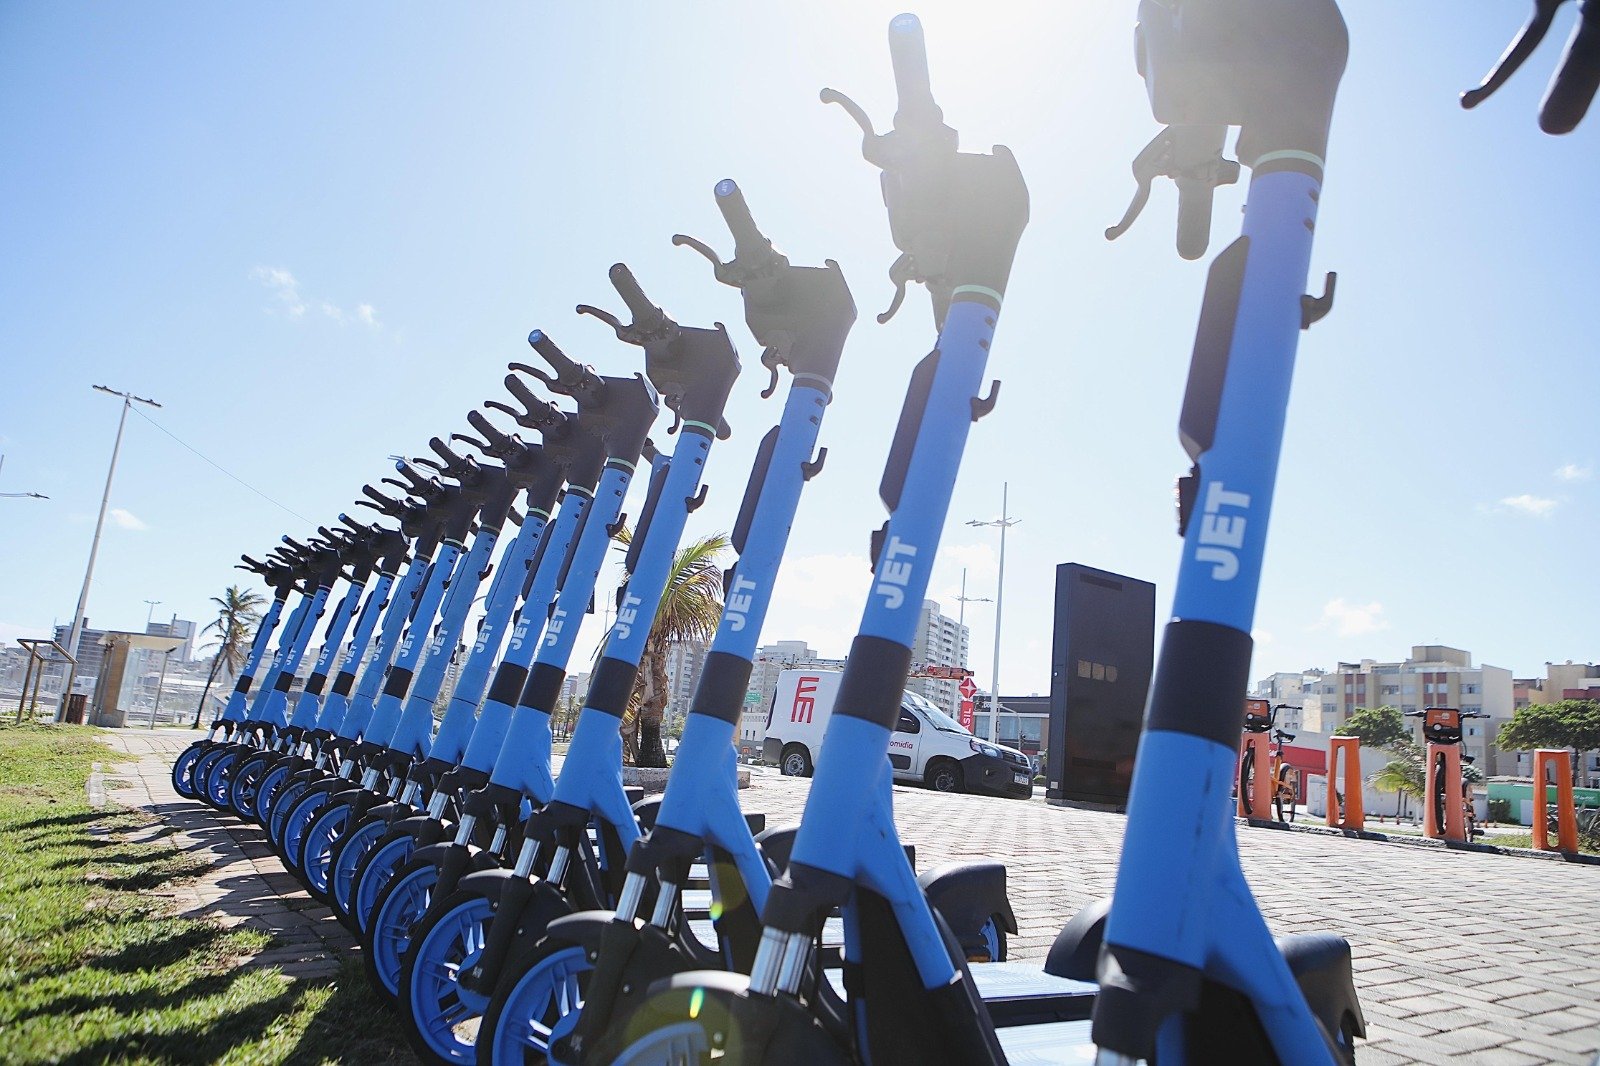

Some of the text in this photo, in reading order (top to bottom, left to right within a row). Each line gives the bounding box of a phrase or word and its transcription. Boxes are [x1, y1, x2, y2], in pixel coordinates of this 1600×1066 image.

[1195, 481, 1251, 581] JET
[876, 536, 917, 609] JET
[614, 592, 642, 640] JET
[725, 574, 757, 632] JET
[432, 626, 448, 656] JET
[475, 621, 493, 653] JET
[510, 614, 531, 650] JET
[546, 605, 568, 647] JET
[286, 648, 297, 665] JET
[319, 646, 330, 666] JET
[345, 643, 357, 664] JET
[373, 640, 385, 661] JET
[401, 632, 415, 657] JET
[274, 652, 283, 668] JET
[889, 741, 913, 750] omidia
